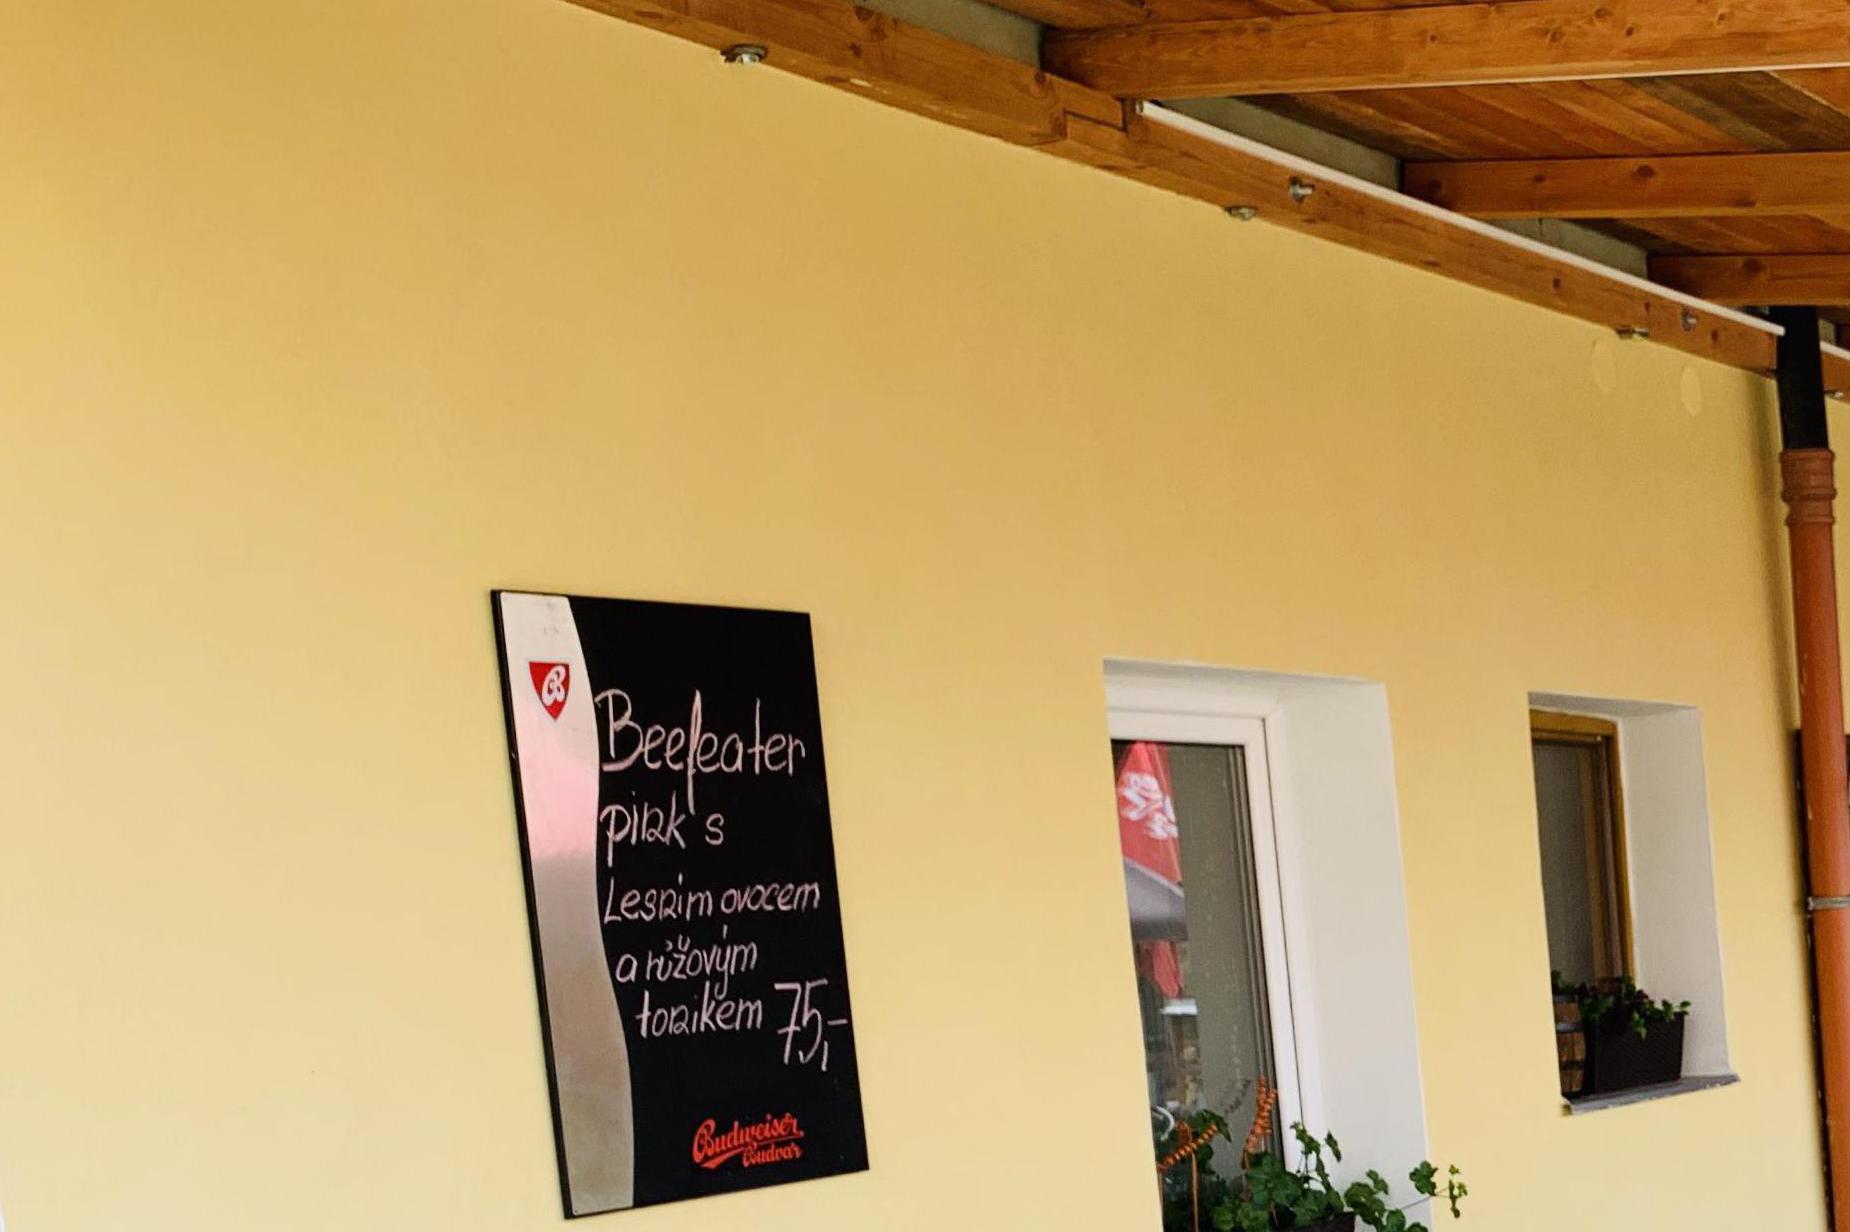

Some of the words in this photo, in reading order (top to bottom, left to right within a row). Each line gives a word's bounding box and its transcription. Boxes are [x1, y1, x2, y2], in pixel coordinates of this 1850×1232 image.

[594, 688, 806, 816] Beefeater
[599, 790, 687, 868] pink
[705, 813, 725, 846] s
[720, 881, 821, 914] ovocem
[616, 953, 638, 983] a
[636, 980, 763, 1039] tonikem
[692, 1111, 805, 1168] Budweiser
[742, 1142, 802, 1168] Budvar
